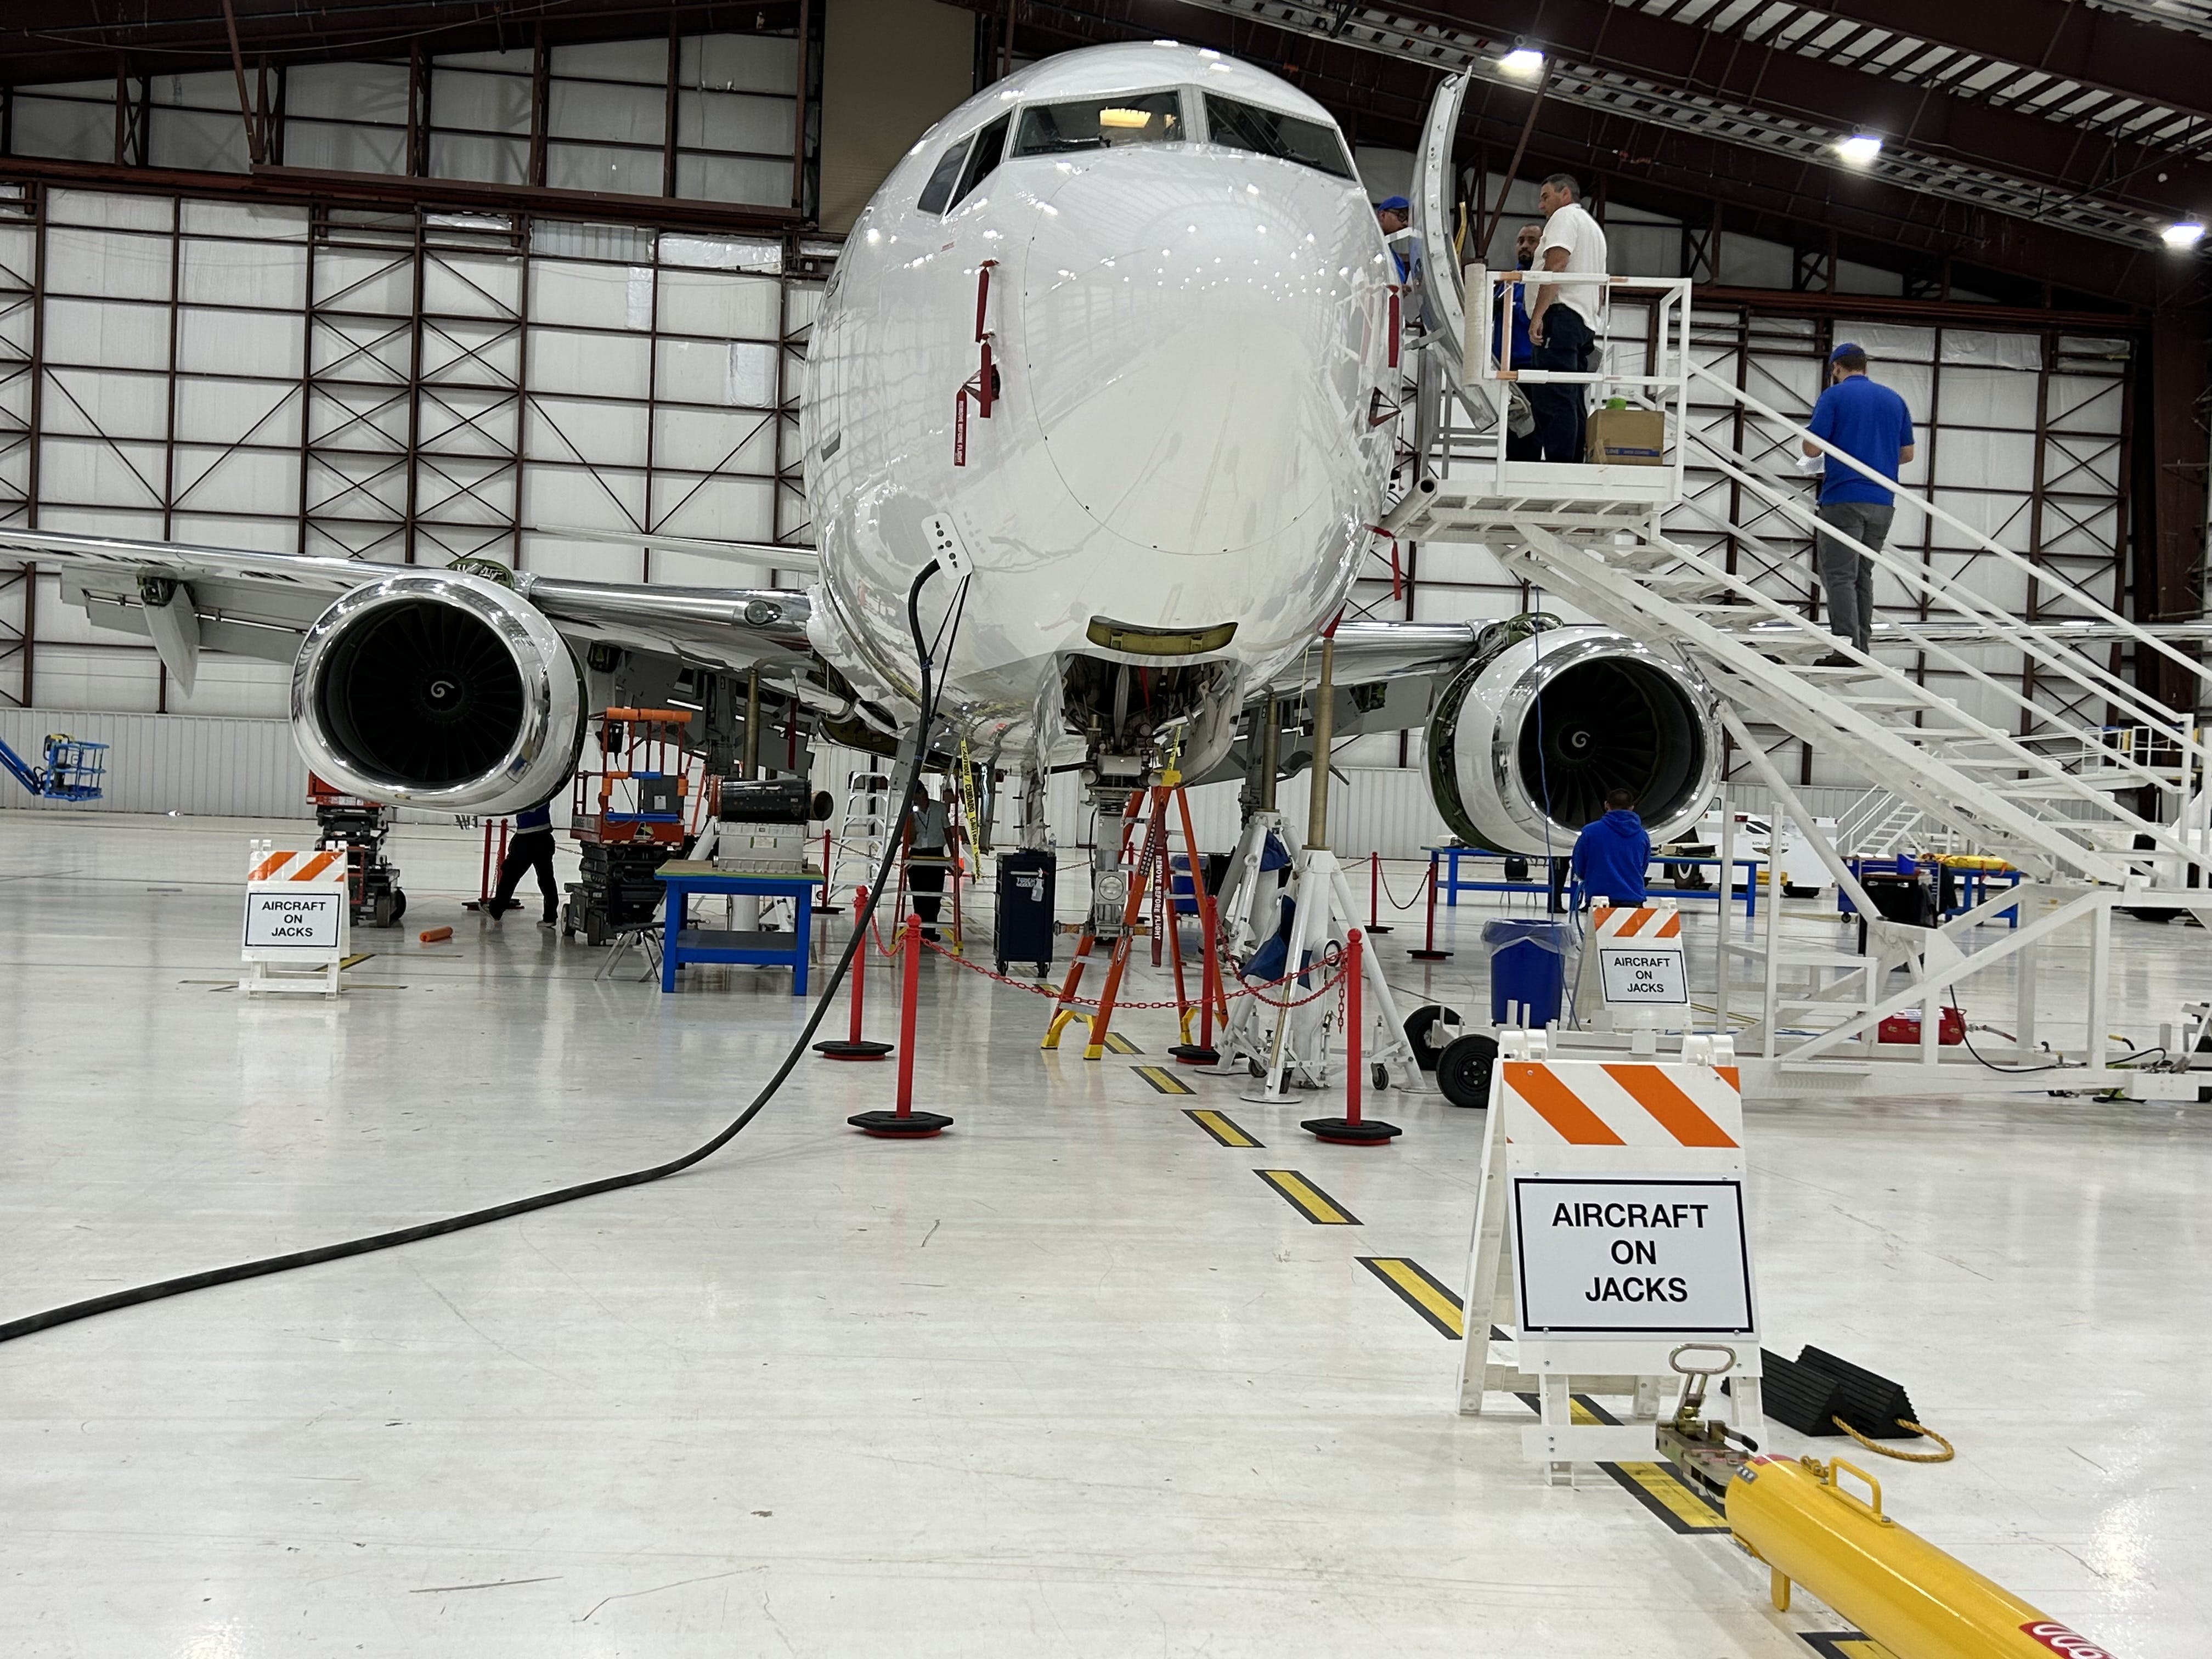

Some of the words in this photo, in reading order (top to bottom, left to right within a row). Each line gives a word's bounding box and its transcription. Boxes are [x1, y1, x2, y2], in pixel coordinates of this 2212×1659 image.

[965, 784, 974, 813] CUIDADO
[262, 901, 326, 911] AIRCRAFT
[284, 914, 303, 924] ON
[271, 927, 313, 937] JACKS
[1613, 957, 1671, 967] AIRCRAFT
[1635, 970, 1652, 980] ON
[1627, 983, 1664, 993] JACKS
[1551, 1203, 1709, 1228] AIRCRAFT
[1611, 1239, 1657, 1265] ON
[1585, 1277, 1688, 1302] JACKS
